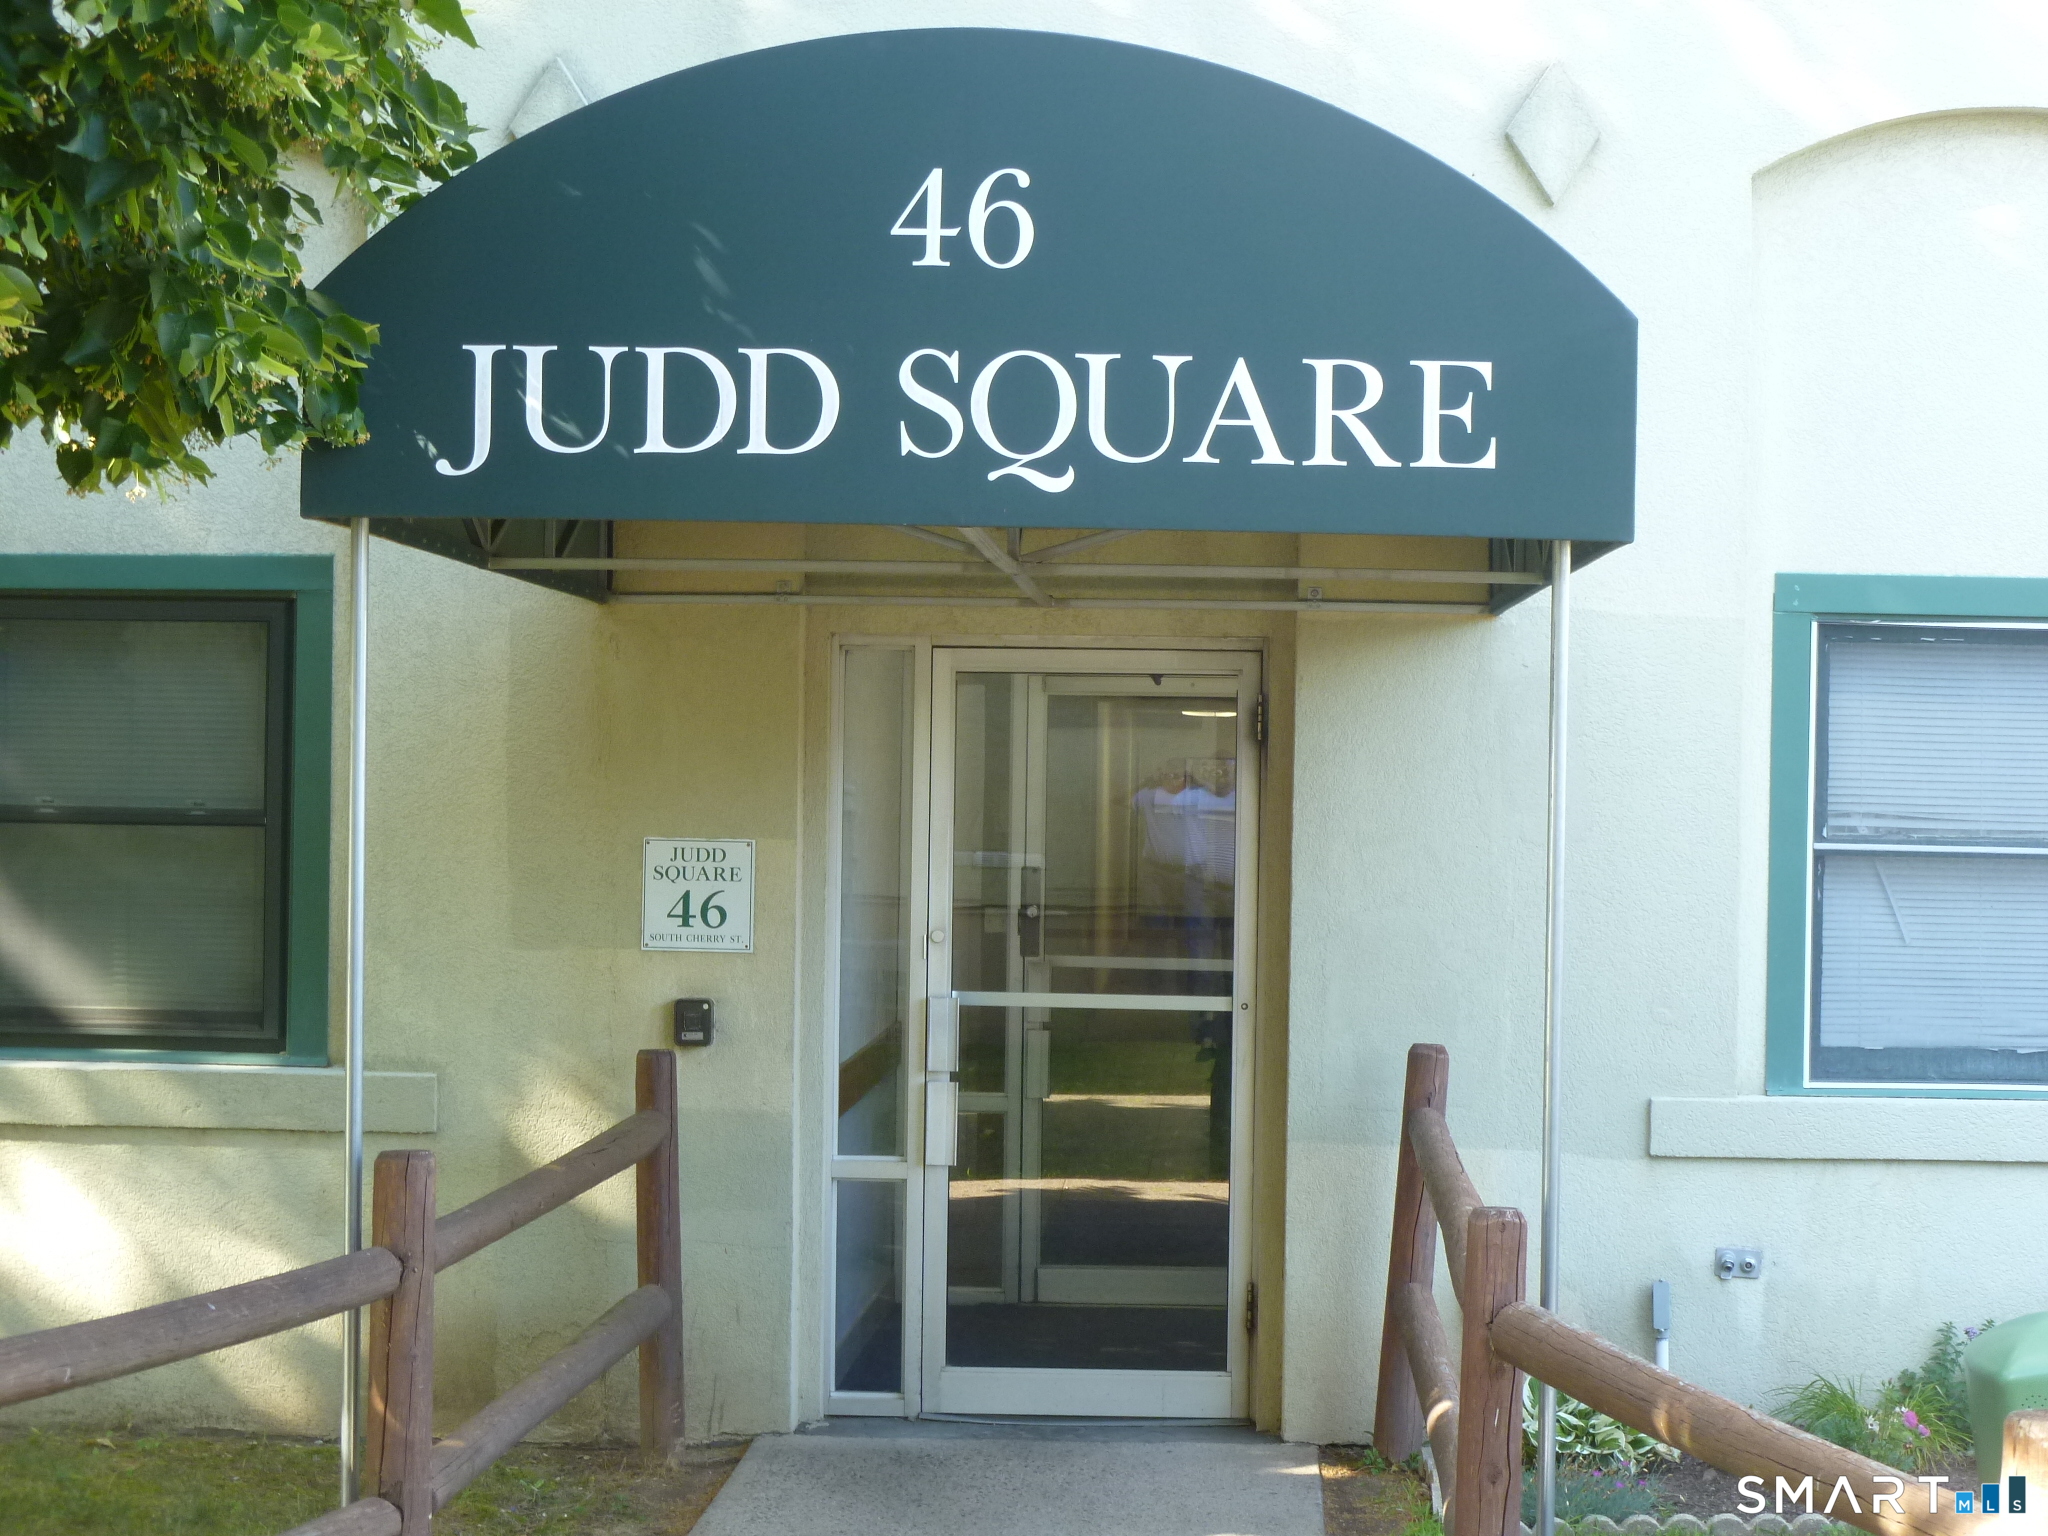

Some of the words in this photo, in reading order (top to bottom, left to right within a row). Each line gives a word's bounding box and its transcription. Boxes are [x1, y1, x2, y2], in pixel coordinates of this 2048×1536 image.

[889, 167, 1035, 270] 46
[434, 344, 841, 478] JUDD
[898, 347, 1497, 494] SQUARE
[670, 847, 727, 863] JUDD
[653, 865, 742, 883] SQUARE
[666, 889, 728, 929] 46
[649, 933, 682, 942] SOUTH
[686, 934, 726, 943] CHERRY
[730, 934, 744, 944] ST.
